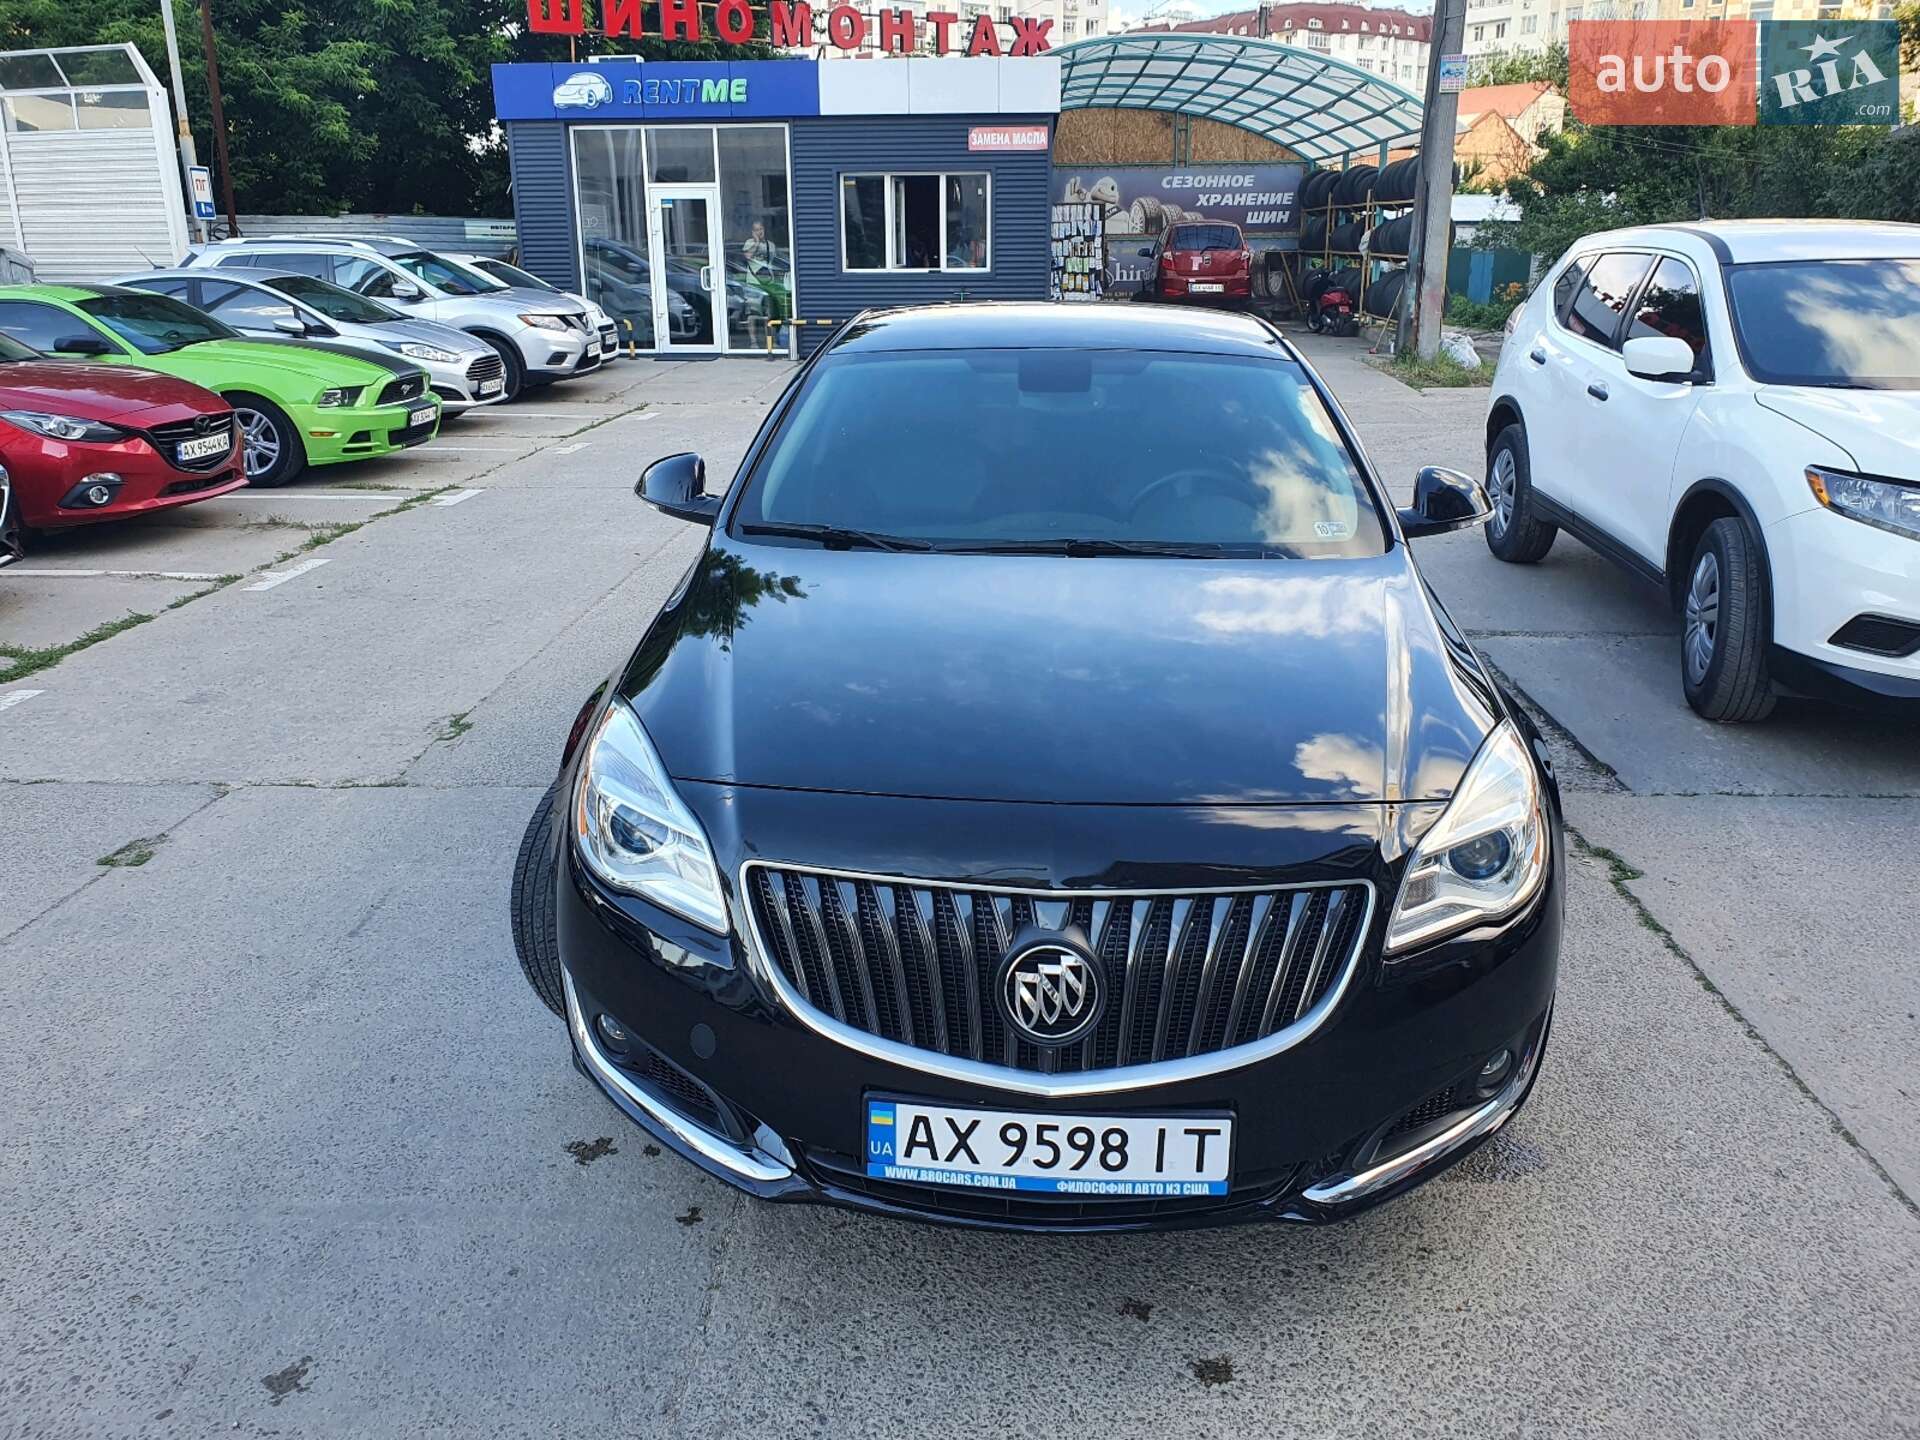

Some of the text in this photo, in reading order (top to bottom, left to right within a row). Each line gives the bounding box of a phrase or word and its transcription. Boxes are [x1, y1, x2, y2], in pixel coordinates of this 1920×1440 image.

[527, 0, 1055, 57] ШИНОМОНТАЖ
[971, 131, 1047, 146] ЗАМЕНА МАСЛА
[1161, 174, 1256, 189] СЕЗОННОЕ
[1196, 191, 1294, 207] ХРАНЕНИЕ
[1245, 210, 1290, 224] ШИН
[183, 444, 197, 457] AX
[870, 1140, 894, 1156] UA
[903, 1114, 981, 1165] AX
[999, 1121, 1129, 1173] 9598
[884, 1165, 1017, 1189] WWW.BROCARS.COM.UA
[1056, 1179, 1211, 1196] ФИЛОСОФИЯ АВТО ИЗ США
